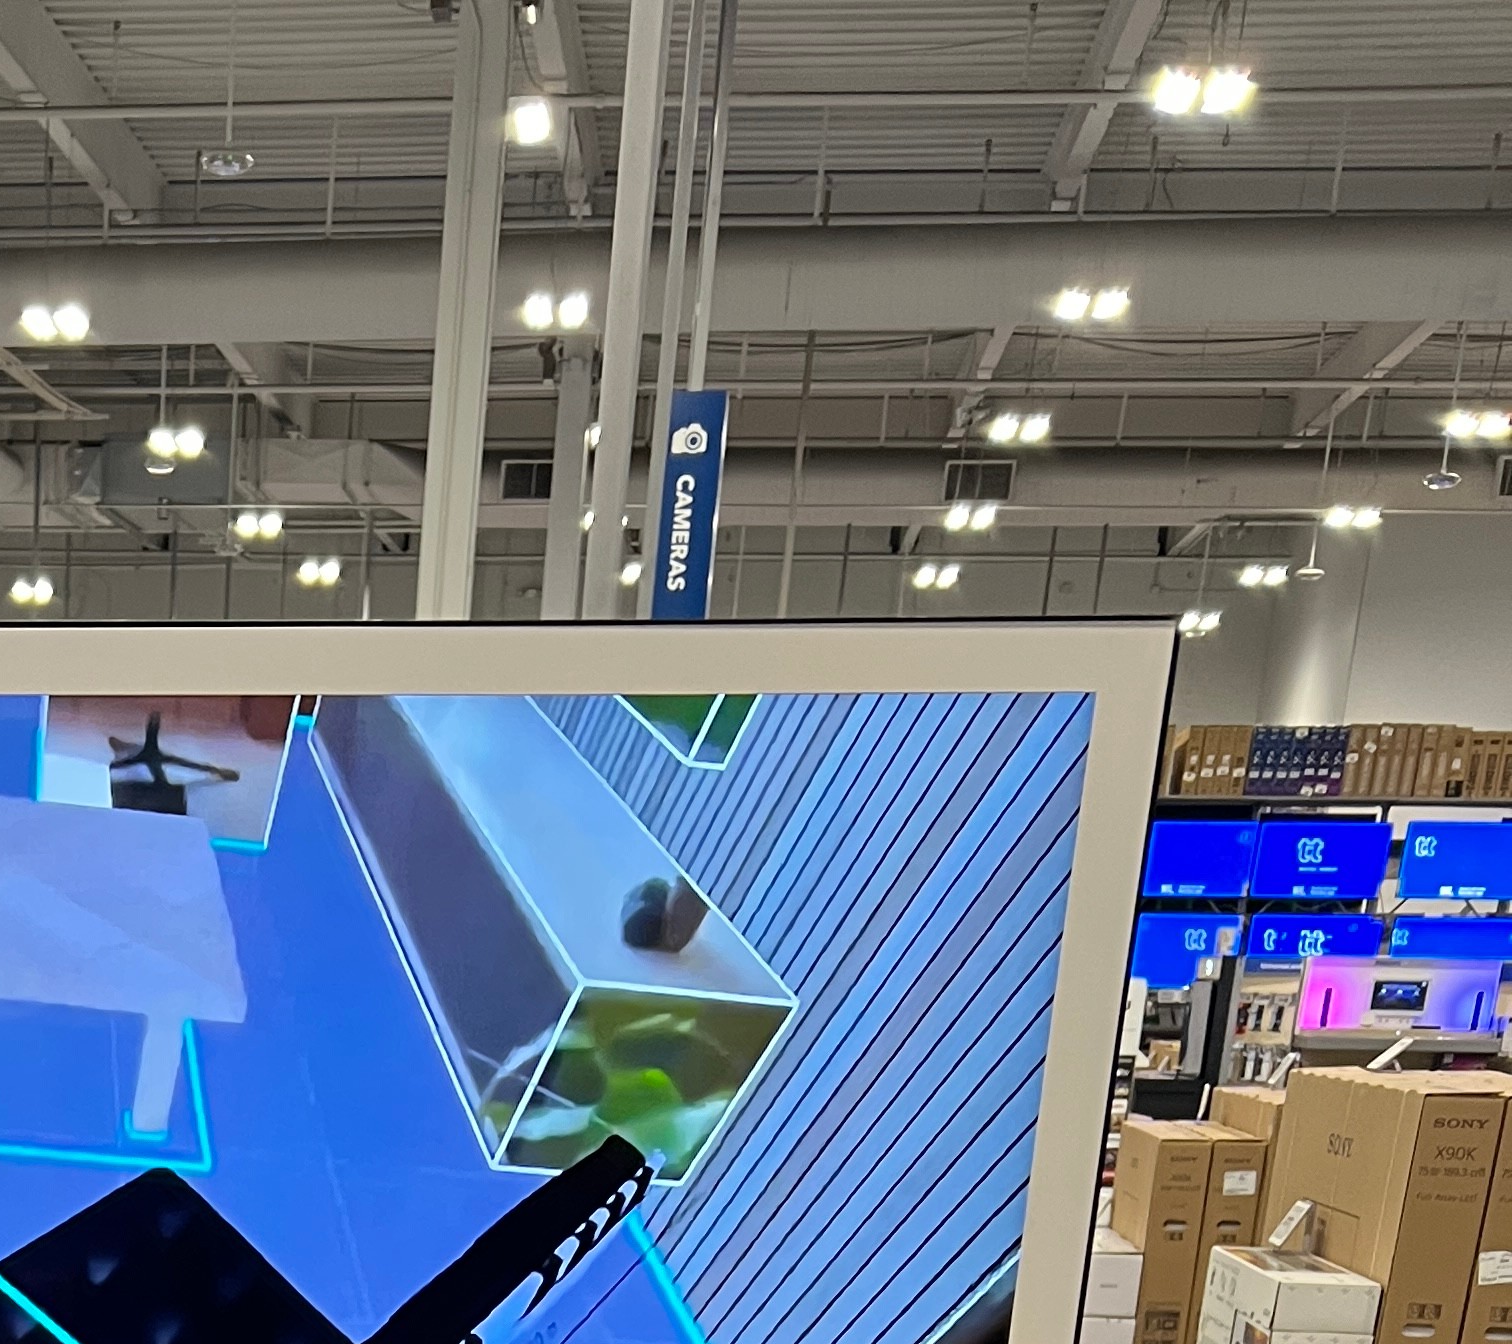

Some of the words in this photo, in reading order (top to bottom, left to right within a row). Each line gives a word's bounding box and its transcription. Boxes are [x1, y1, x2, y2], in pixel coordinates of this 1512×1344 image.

[666, 474, 695, 592] CAMERAS
[1433, 1118, 1489, 1129] SONY
[1434, 1146, 1477, 1161] X90K
